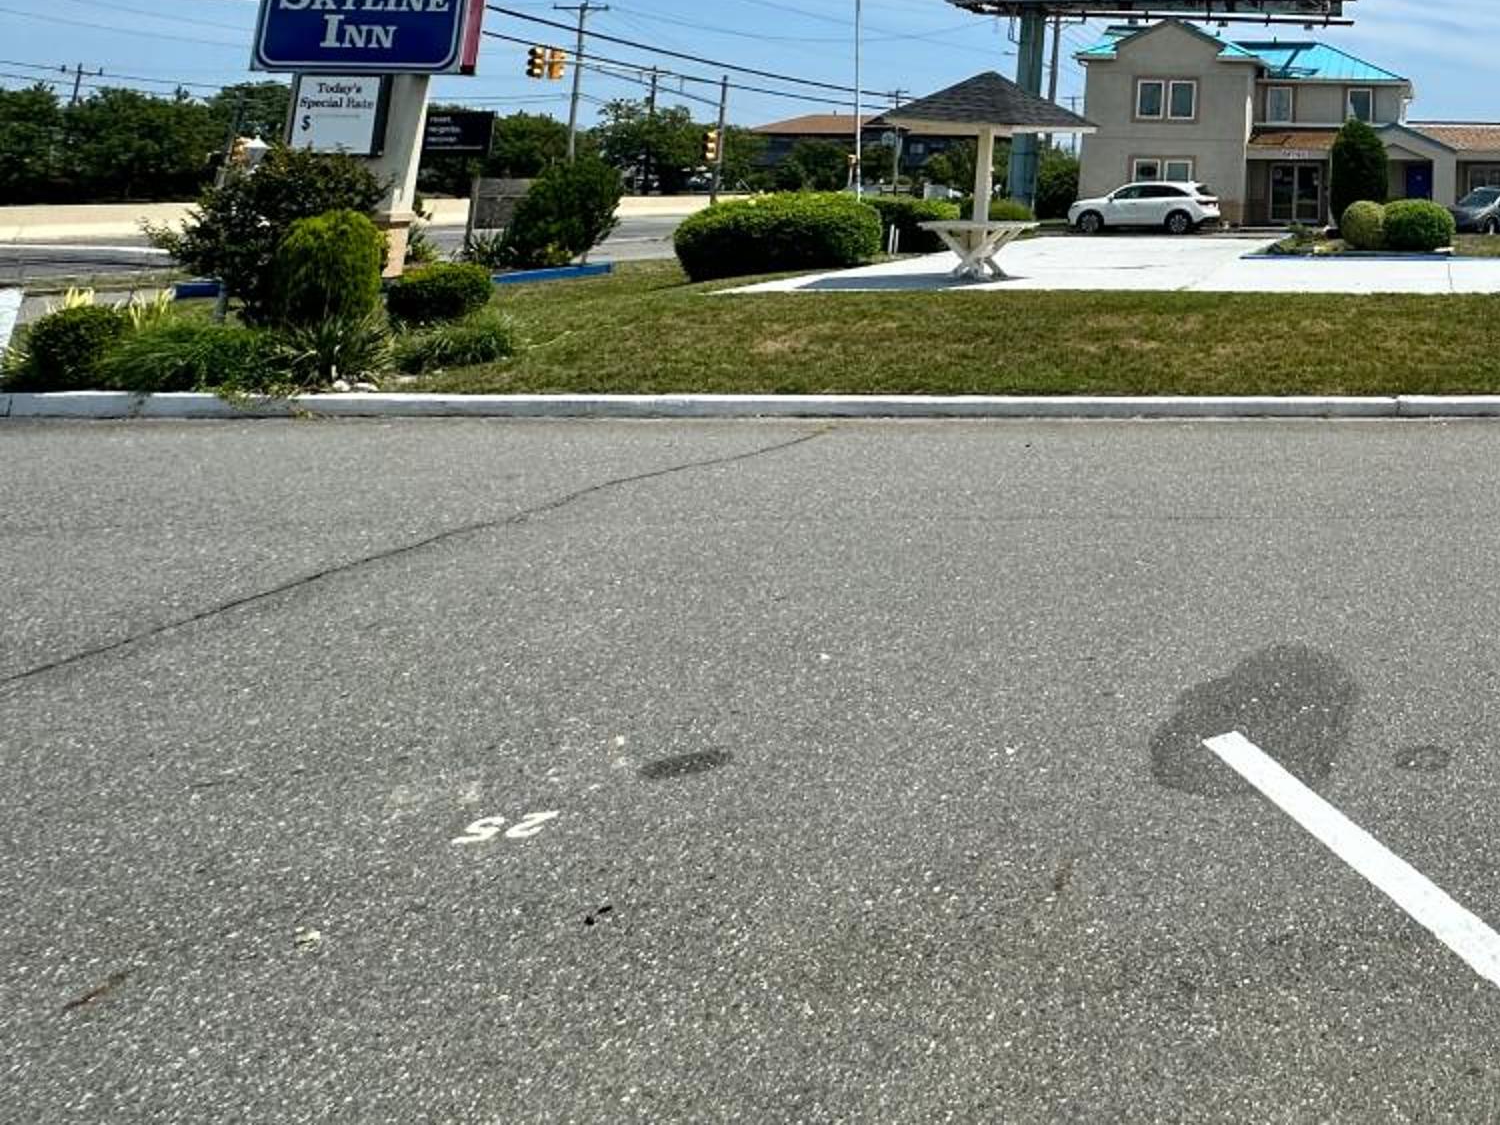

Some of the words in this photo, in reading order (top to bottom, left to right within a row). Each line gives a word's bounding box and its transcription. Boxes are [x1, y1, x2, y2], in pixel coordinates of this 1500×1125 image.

[318, 82, 362, 95] Today's
[300, 97, 343, 110] Special
[346, 97, 374, 109] Rate
